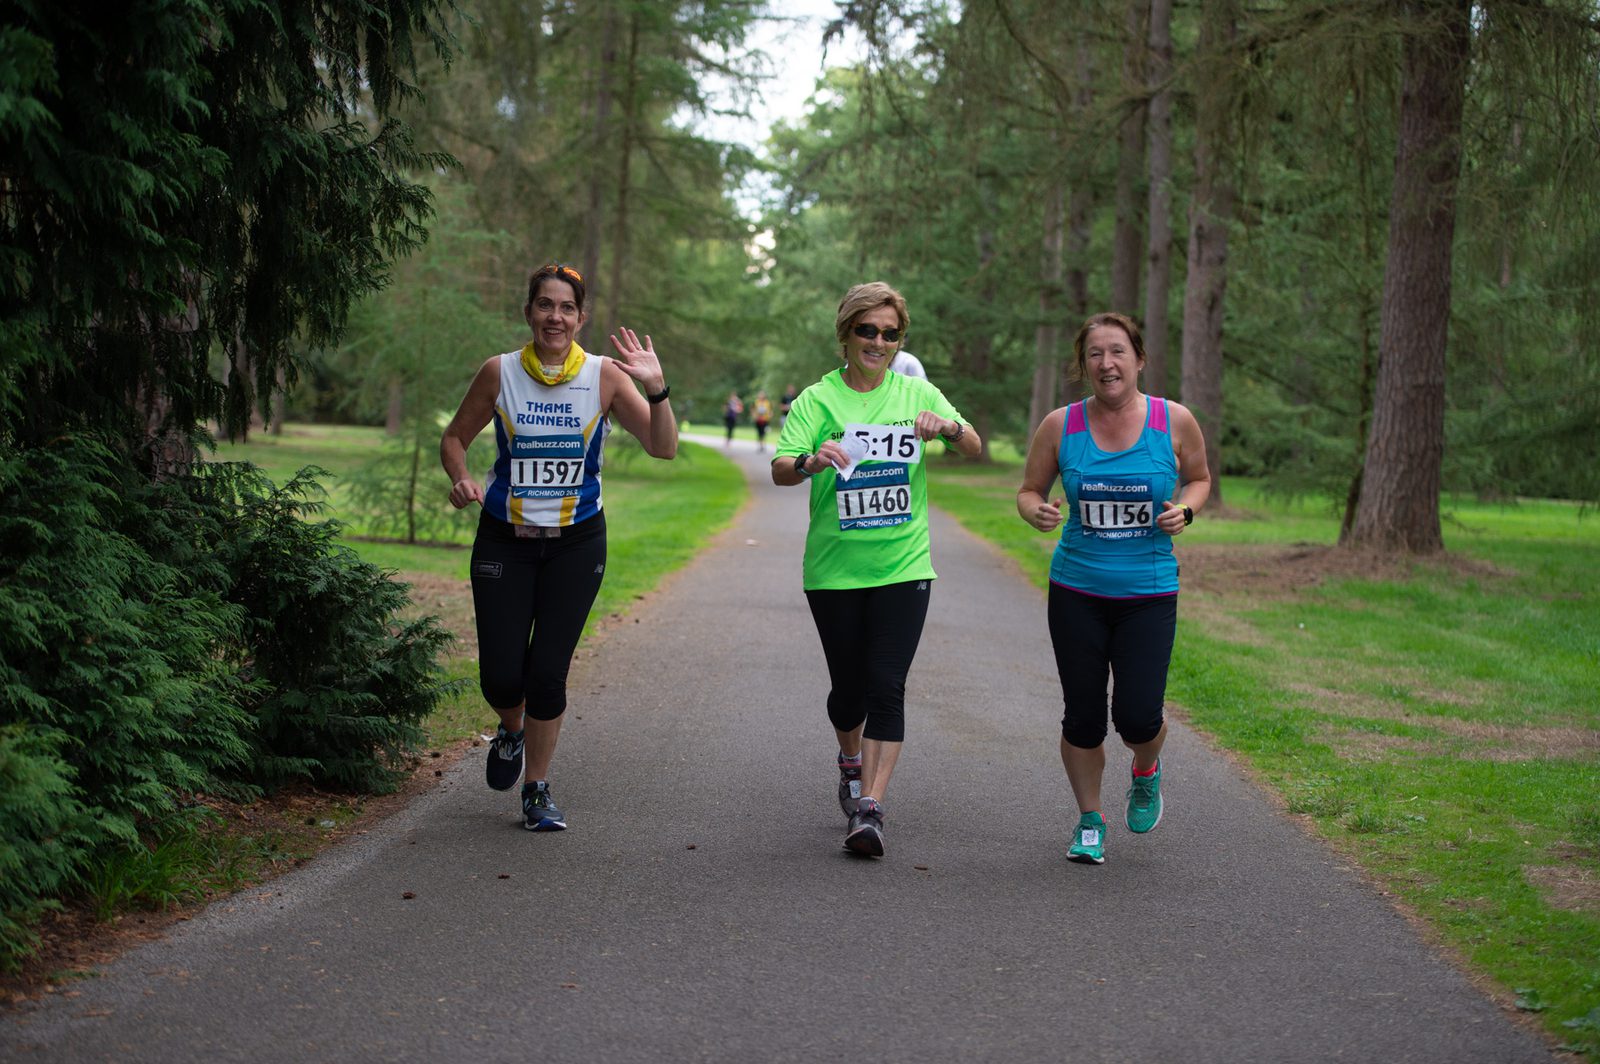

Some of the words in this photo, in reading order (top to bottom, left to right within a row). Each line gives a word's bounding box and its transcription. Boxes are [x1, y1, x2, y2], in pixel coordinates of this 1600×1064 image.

[526, 401, 572, 414] THAME
[516, 413, 581, 428] RUNNERS
[516, 440, 580, 450] realbuzz.com
[518, 461, 583, 485] 11597
[841, 466, 904, 480] ralbuzz.com
[527, 489, 565, 497] RICHMOND
[1082, 483, 1148, 493] realbuzz.com
[844, 488, 909, 516] 11460
[1085, 503, 1150, 526] 11156
[856, 519, 894, 528] RICHMOND
[1096, 530, 1133, 539] RICHMOND
